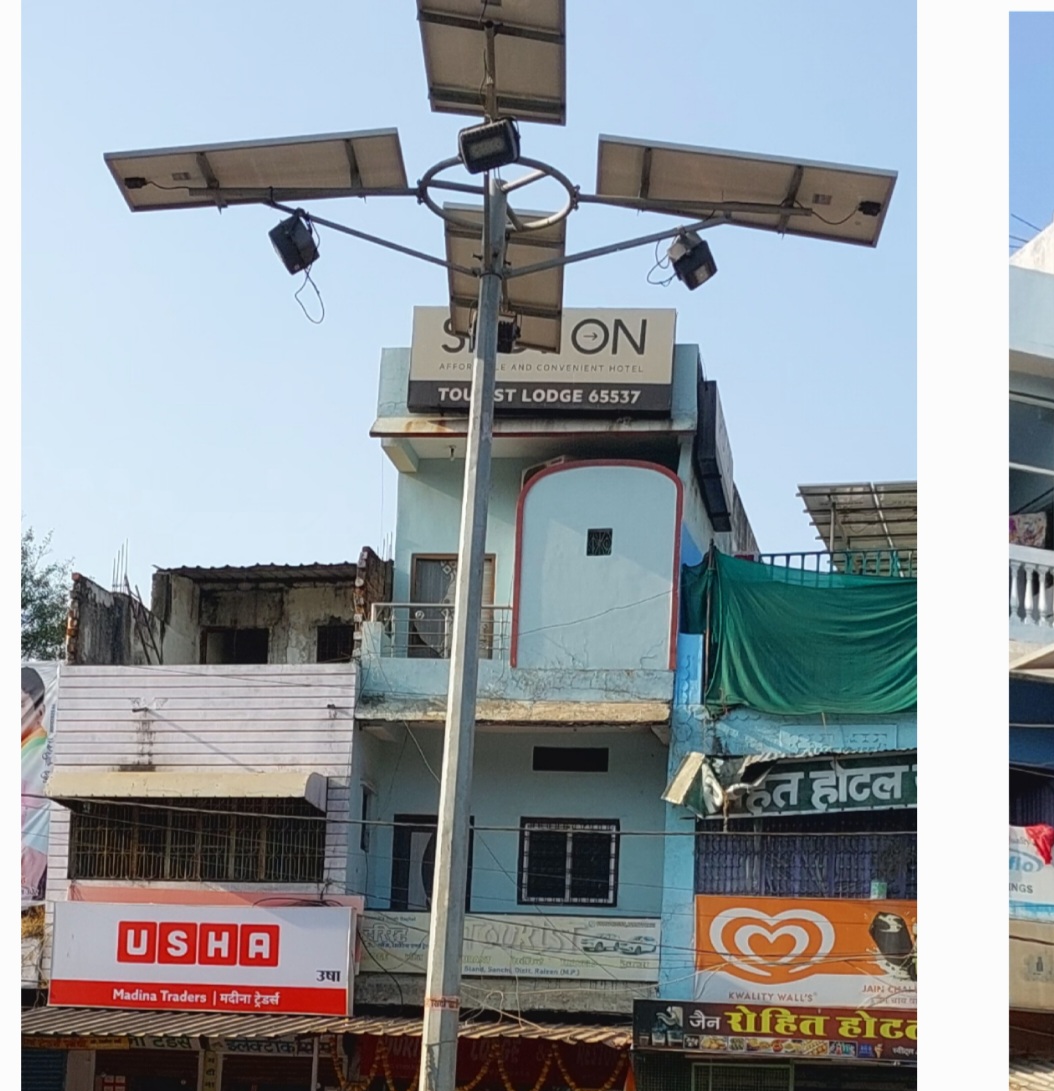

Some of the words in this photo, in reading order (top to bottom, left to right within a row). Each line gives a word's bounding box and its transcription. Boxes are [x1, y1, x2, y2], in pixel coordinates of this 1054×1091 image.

[571, 318, 647, 355] ON
[439, 362, 507, 372] AFFORE
[511, 363, 533, 373] AND
[536, 364, 605, 373] CONVENIENT
[608, 365, 644, 374] HOTEL
[438, 387, 518, 403] TOUST
[522, 388, 583, 403] LODGE
[588, 388, 641, 405] 65537
[809, 762, 910, 811] होटल
[122, 926, 273, 962] USHA
[316, 970, 341, 983] उषा
[113, 988, 157, 1003] Madina
[160, 990, 207, 1004] Traders
[220, 992, 251, 1005] मदीना
[254, 992, 280, 1009] ट्रेडर्स
[728, 991, 774, 1001] KWALITY
[777, 992, 813, 1002] WALL'S
[689, 1010, 721, 1030] जैन
[724, 1005, 831, 1036] रोहित
